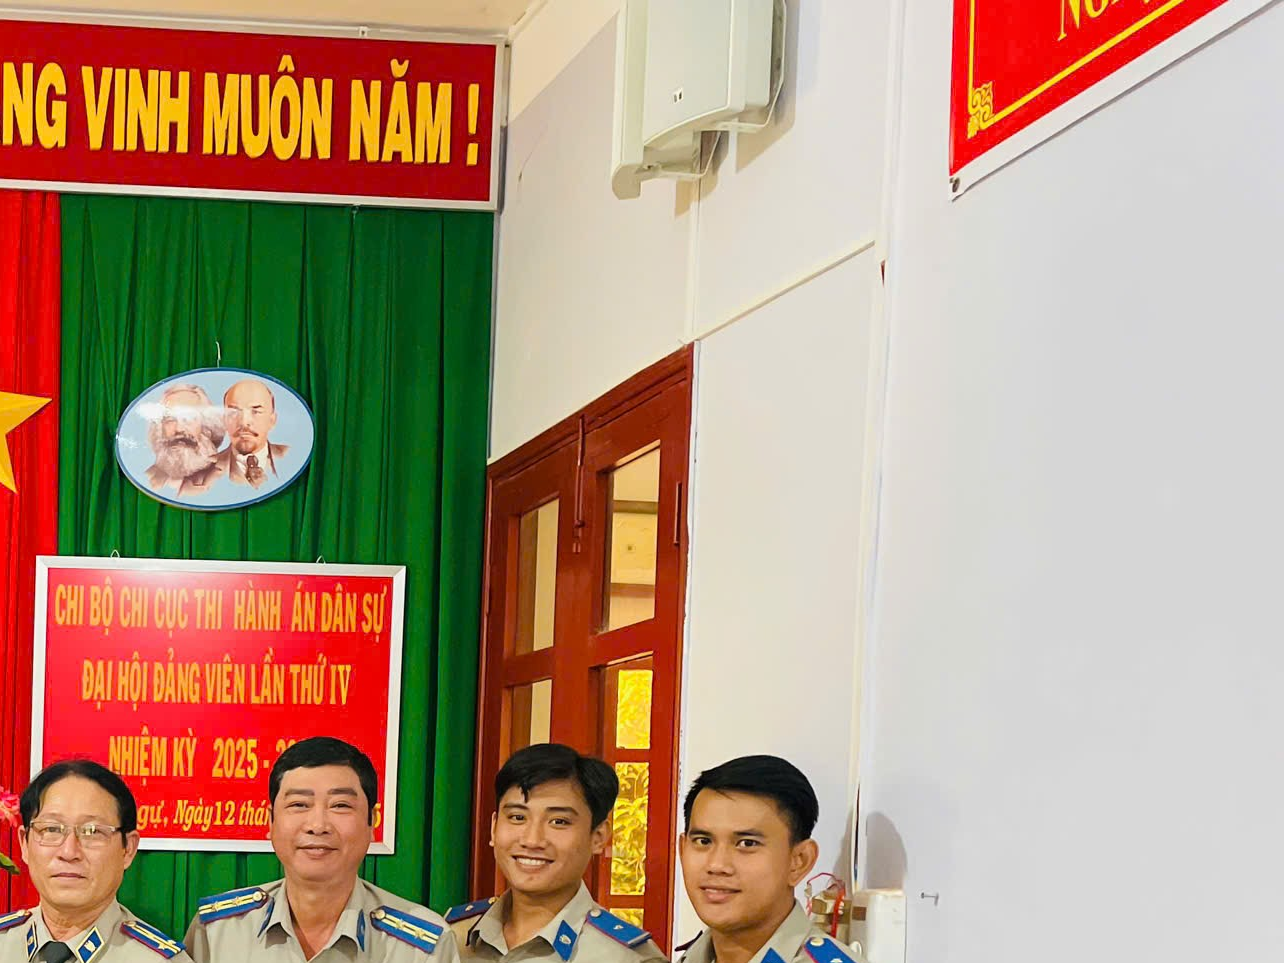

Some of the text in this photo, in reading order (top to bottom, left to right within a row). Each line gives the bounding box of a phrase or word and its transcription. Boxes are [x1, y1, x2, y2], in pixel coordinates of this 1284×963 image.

[82, 66, 189, 152] VINH
[203, 55, 332, 160] MUÔN
[349, 59, 452, 163] NĂM
[467, 84, 479, 165] !
[55, 576, 388, 639] CHI BỘ CHI CỤC THI HÀNH ÁN DÂN SỰ
[83, 648, 351, 710] ĐẠI HỘI ĐẢNG VIÊN LẦN THỨ IV
[109, 726, 166, 785] NHIỆM
[173, 729, 196, 776] KỲ
[213, 738, 257, 778] 2025
